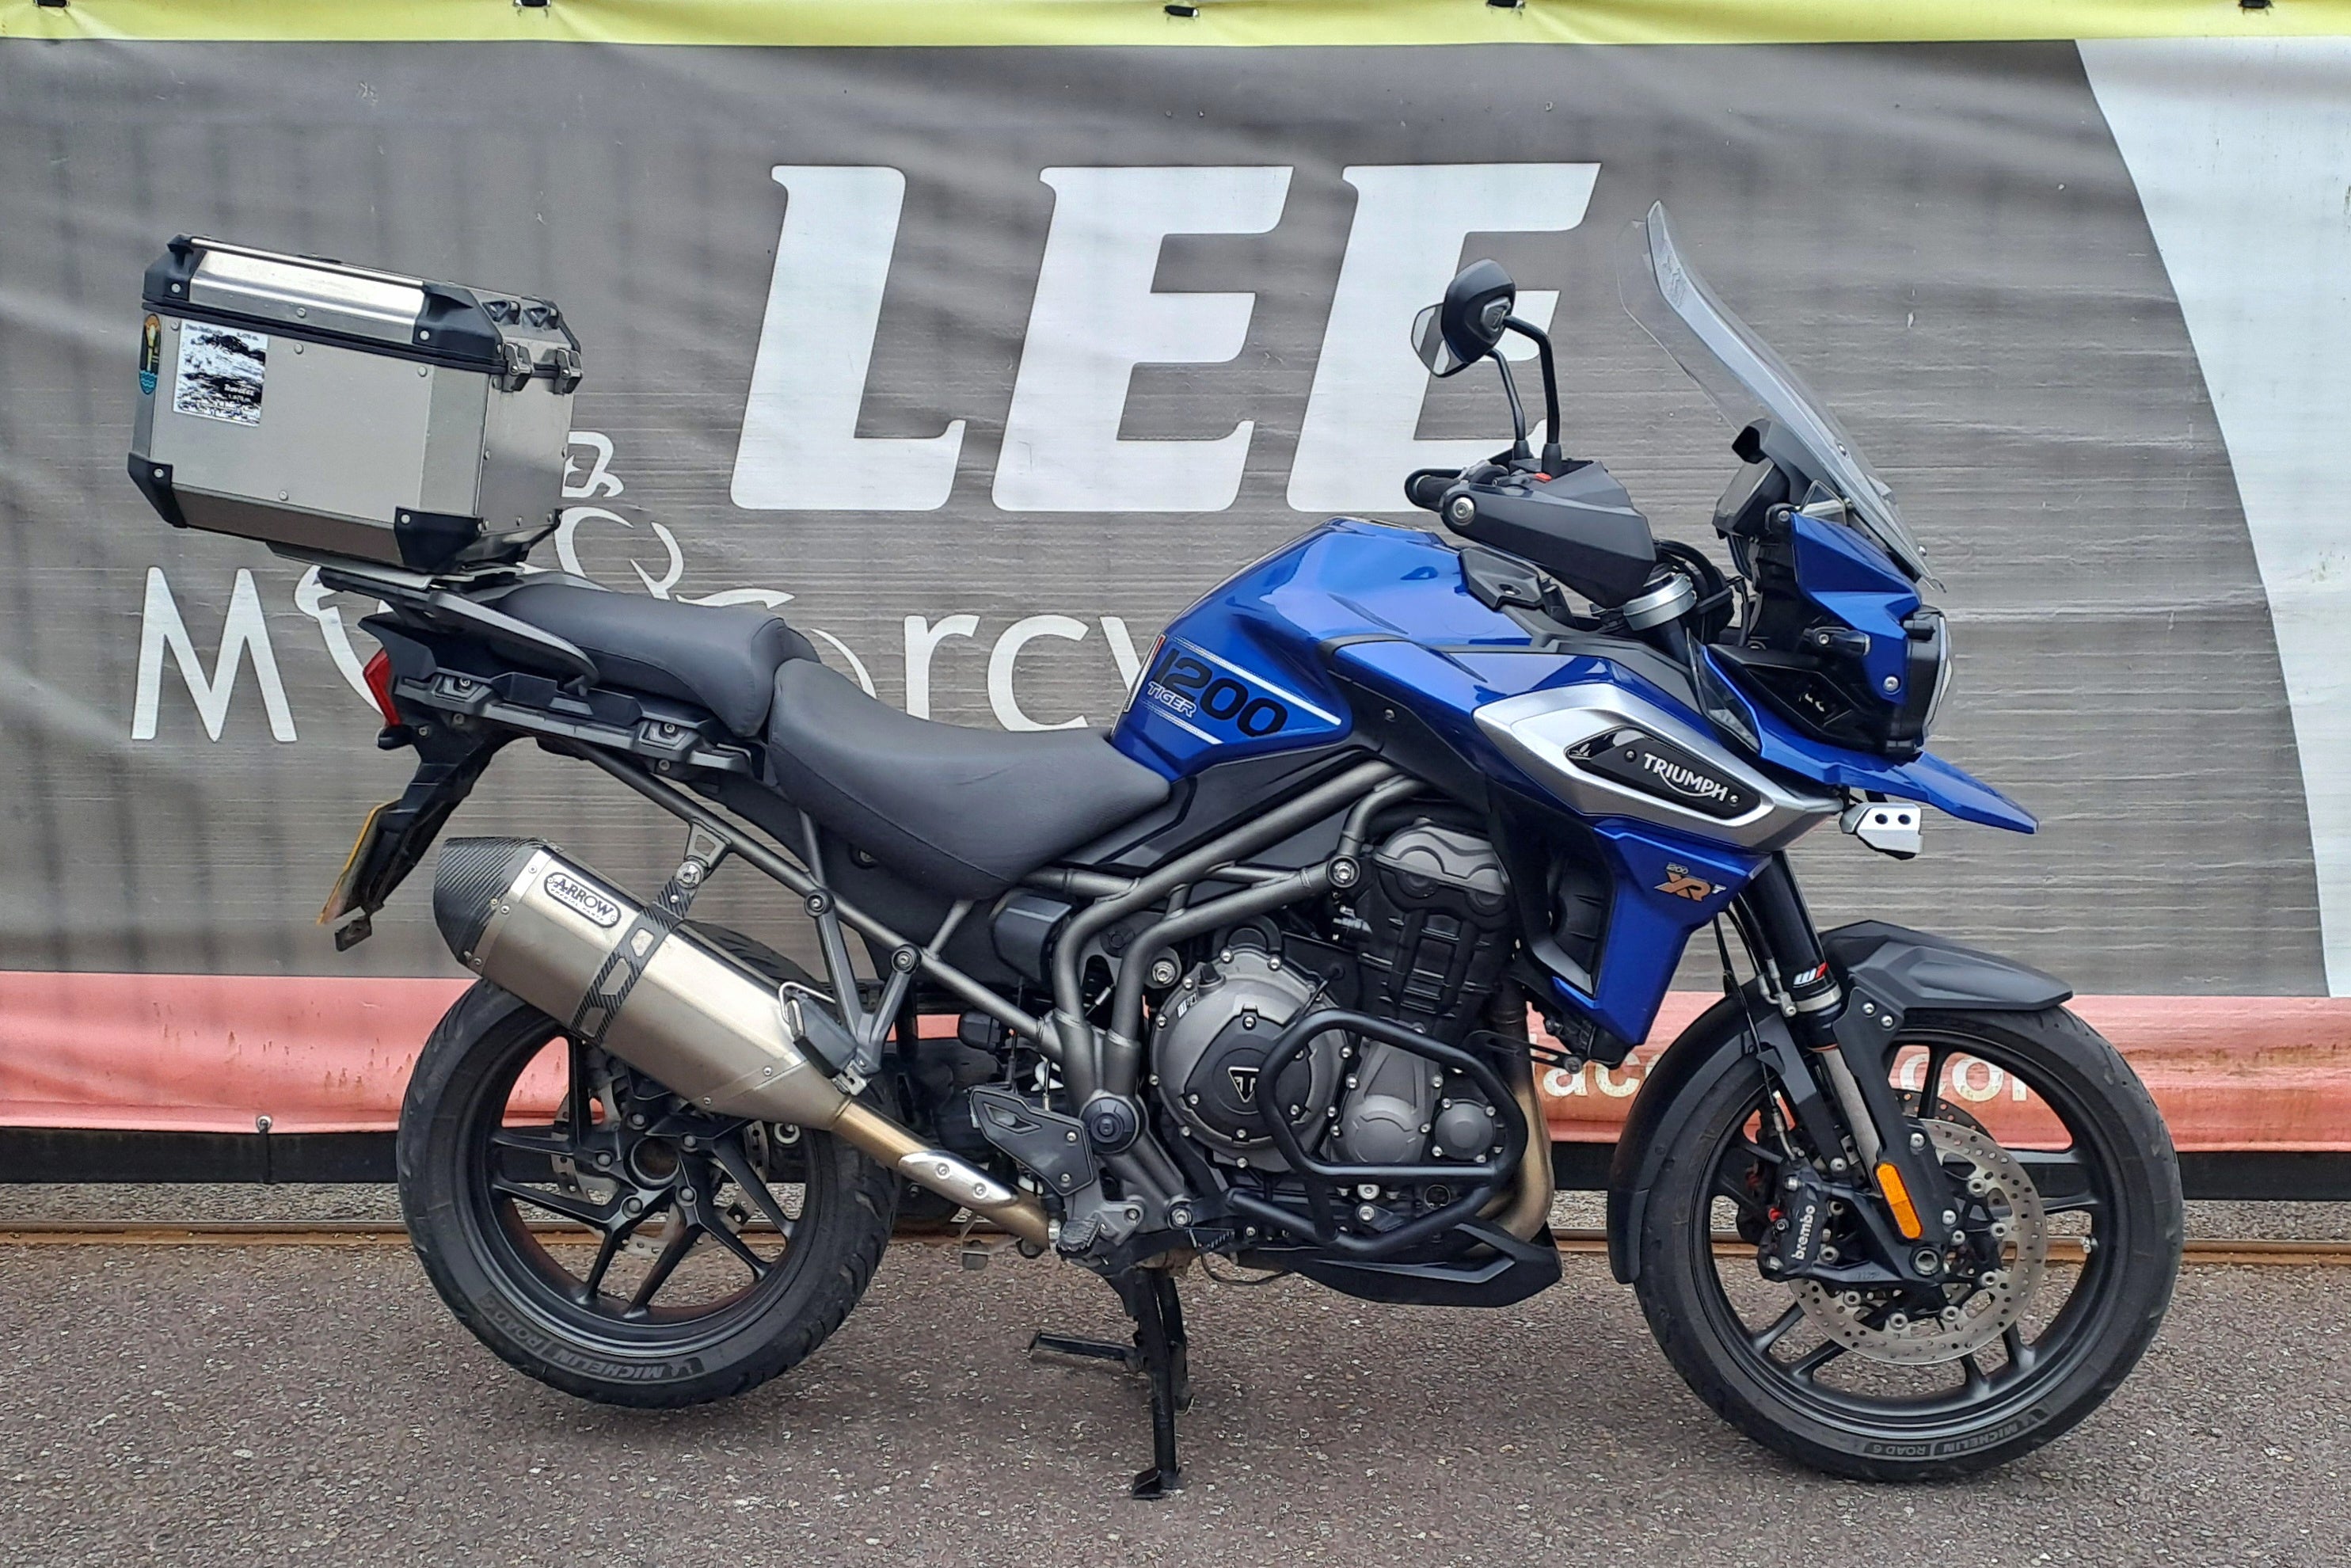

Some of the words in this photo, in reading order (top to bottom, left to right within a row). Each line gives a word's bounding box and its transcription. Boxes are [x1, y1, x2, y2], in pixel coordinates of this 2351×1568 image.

[730, 162, 1601, 512] LEE
[1147, 681, 1196, 717] TIGER
[1151, 648, 1288, 737] 1200
[1644, 752, 1729, 801] TRIUMPH
[553, 878, 614, 916] ARROW
[1791, 1205, 1816, 1260] brembo
[554, 1348, 665, 1379] MICHELIN
[1886, 1444, 1927, 1456] ROAD
[1942, 1421, 2018, 1454] MICHELIN
